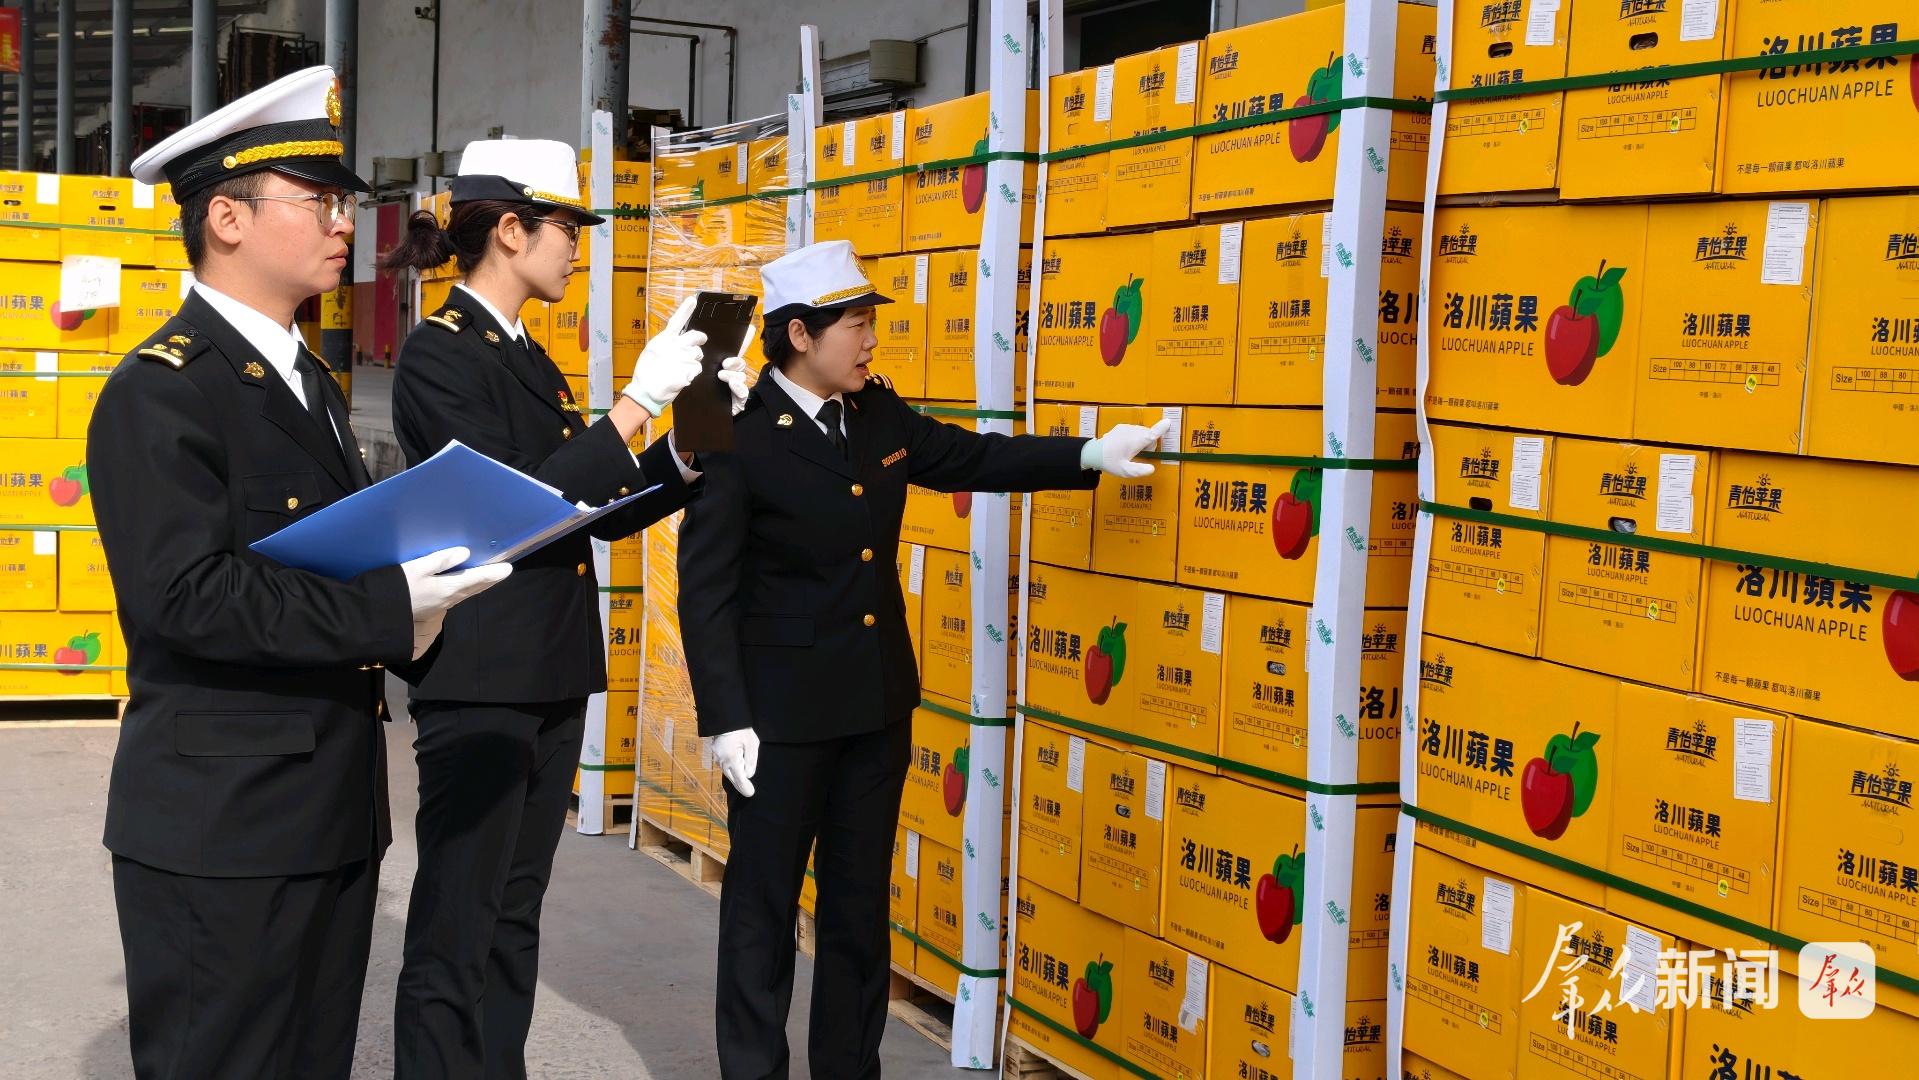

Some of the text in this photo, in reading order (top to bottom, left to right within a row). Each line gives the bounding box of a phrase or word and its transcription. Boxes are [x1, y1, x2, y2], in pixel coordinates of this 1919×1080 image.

[1646, 90, 1669, 100] APPLE
[1757, 79, 1894, 108] LUOCHUAN APPLE
[1210, 132, 1281, 154] LUOCHUAN APPLE
[1439, 235, 1478, 254] 青怡苹果
[1694, 236, 1748, 257] 青怡苹果
[1041, 301, 1096, 330] 洛川蘋果
[1173, 304, 1209, 324] 洛川蘋果
[1268, 299, 1311, 320] 洛川蘋果
[1443, 292, 1539, 334] 洛川蘋果
[1682, 313, 1750, 337] 洛川蘋果
[1441, 337, 1534, 356] LUOCHUAN APPLE
[1682, 339, 1749, 350] LUOCHUAN APPLE
[1652, 364, 1667, 373] Size
[1835, 373, 1853, 383] Size
[1860, 370, 1871, 378] 100
[1460, 456, 1499, 477] 青怡苹果
[1194, 478, 1267, 515] 洛川蘋果
[1599, 473, 1647, 496] 青怡苹果
[1727, 485, 1782, 509] 青怡苹果
[1193, 516, 1264, 535] LUOCHUAN APPLE
[1451, 521, 1502, 548] 洛川蘋果
[1588, 542, 1650, 574] 洛川蘋果
[1587, 567, 1648, 585] LUOCHUAN APPLE
[1734, 604, 1868, 642] LUOCHUAN APPLE
[1029, 624, 1081, 662] 洛川蘋果
[1156, 663, 1192, 687] 洛川蘋果
[1252, 681, 1295, 708] 洛川蘋果
[1421, 717, 1515, 778] 洛川蘋果
[1665, 727, 1718, 758] 青怡苹果
[1420, 761, 1511, 801] LUOCHUAN APPLE
[1850, 769, 1914, 805] 青怡苹果
[1654, 798, 1721, 838] 洛川蘋果
[1103, 823, 1137, 850] 洛川蘋果
[1626, 841, 1640, 854] Size
[1653, 823, 1720, 850] LUOCHUAN APPLE
[1180, 836, 1251, 890] 洛川蘋果
[1837, 847, 1918, 894] 洛川蘋果
[1179, 874, 1249, 910] LUOCHUAN APPLE
[1437, 882, 1476, 912] 青怡苹果
[1836, 876, 1917, 907] LUOCHUAN APPLE
[1802, 895, 1820, 908] Size
[1827, 898, 1838, 906] 100
[1864, 909, 1873, 917] 80
[1883, 914, 1891, 923] 72
[1018, 941, 1069, 991] 洛川蘋果
[1427, 944, 1479, 983] 洛川蘋果
[1143, 1010, 1178, 1043] 洛川蘋果
[1594, 1038, 1616, 1056] APPLE
